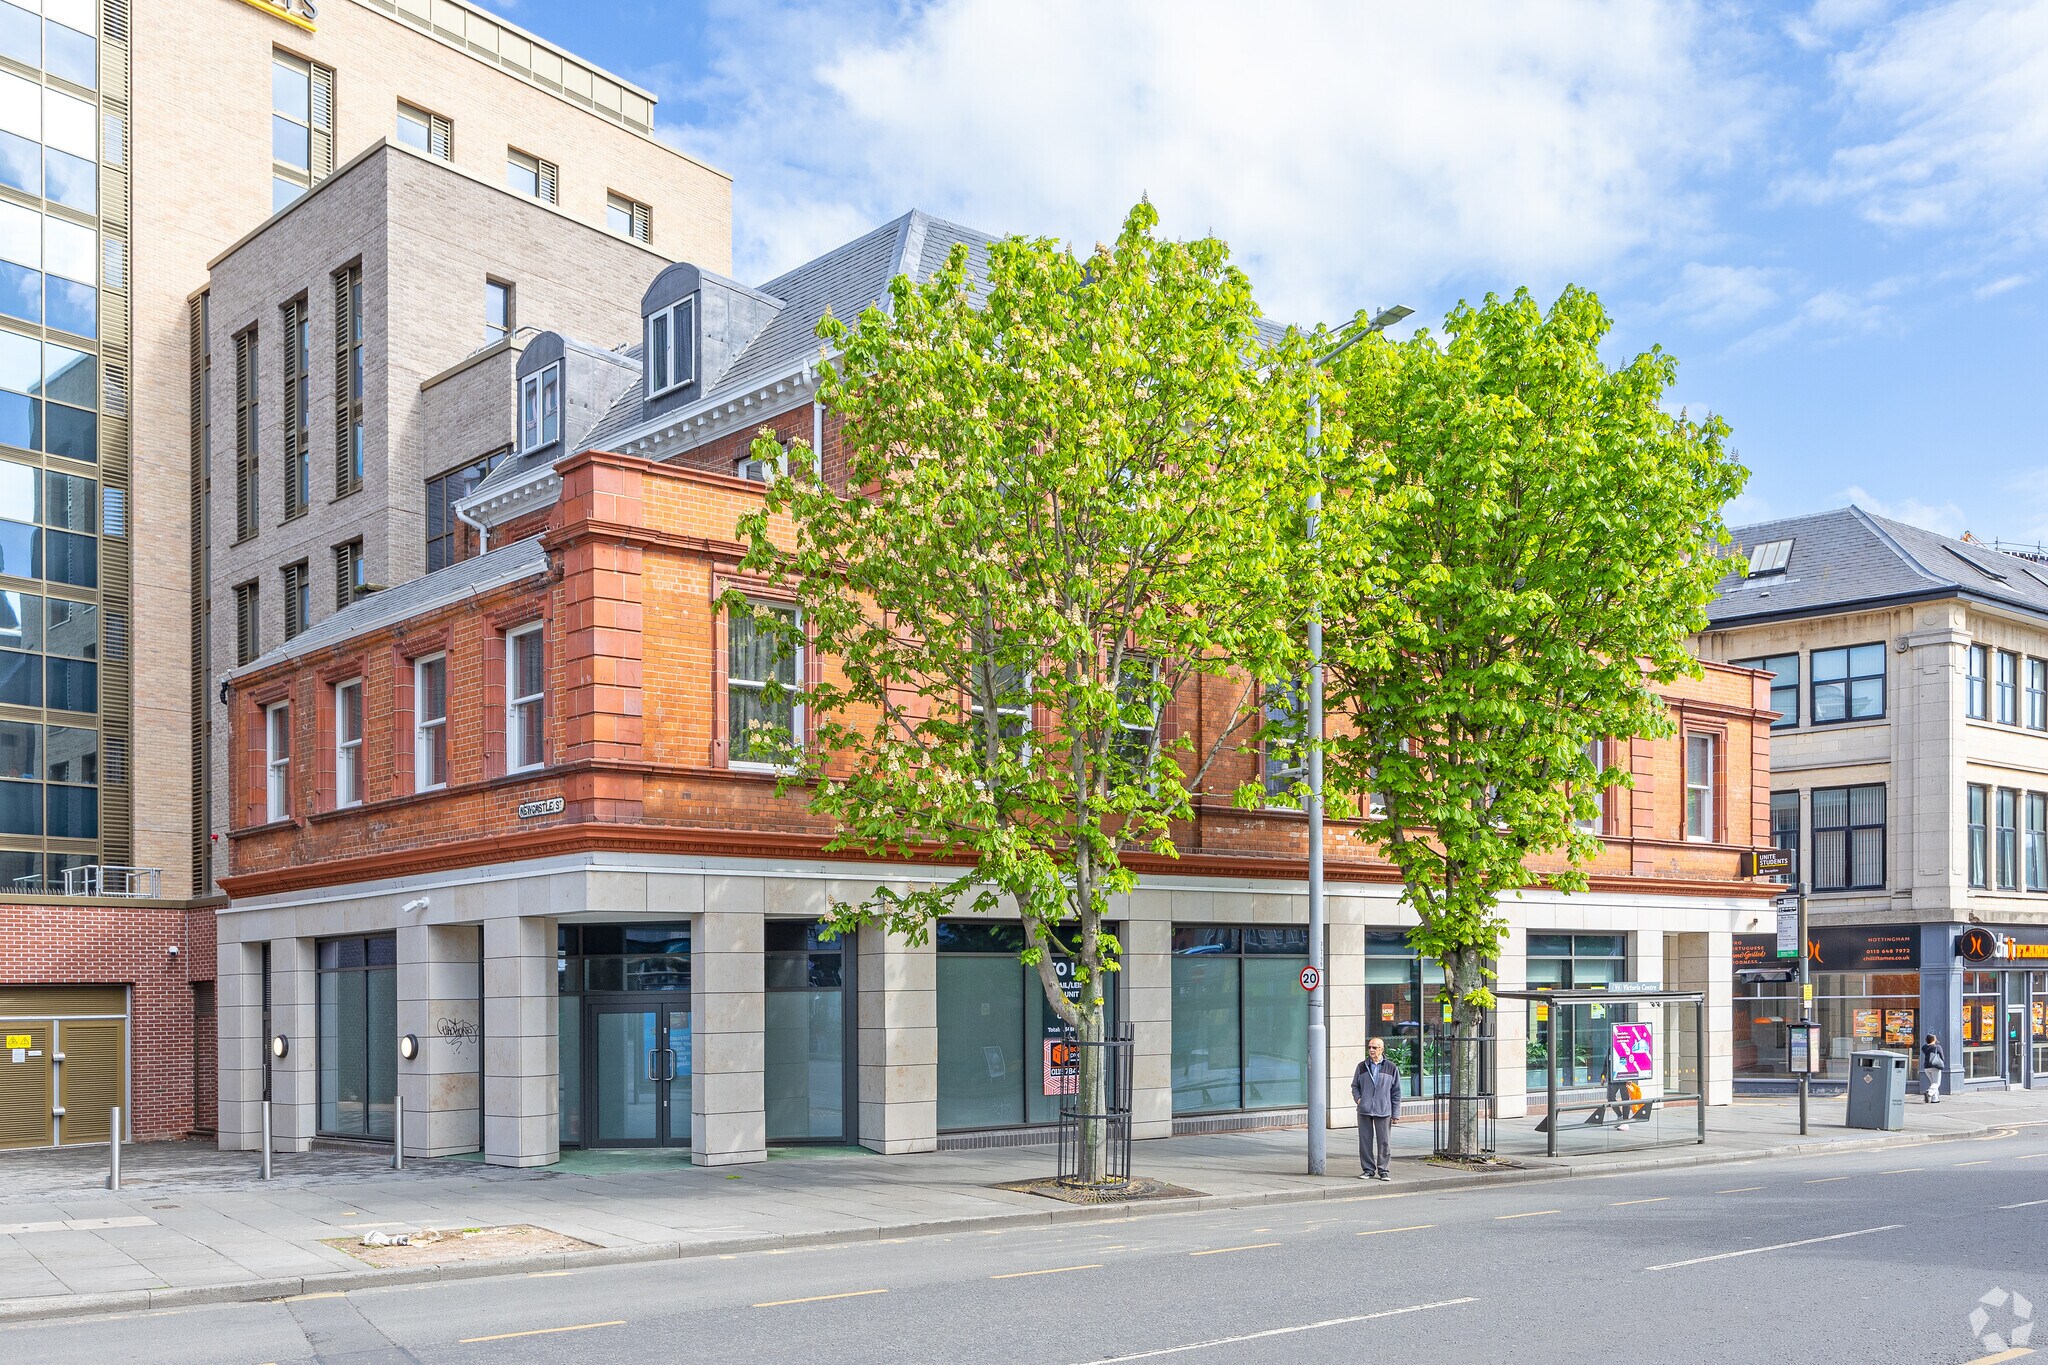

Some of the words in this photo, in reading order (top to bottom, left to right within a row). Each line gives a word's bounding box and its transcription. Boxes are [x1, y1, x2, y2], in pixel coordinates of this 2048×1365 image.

[520, 801, 554, 816] NEWCASTLE
[1759, 858, 1788, 866] STUDENTS
[1303, 973, 1316, 984] 20
